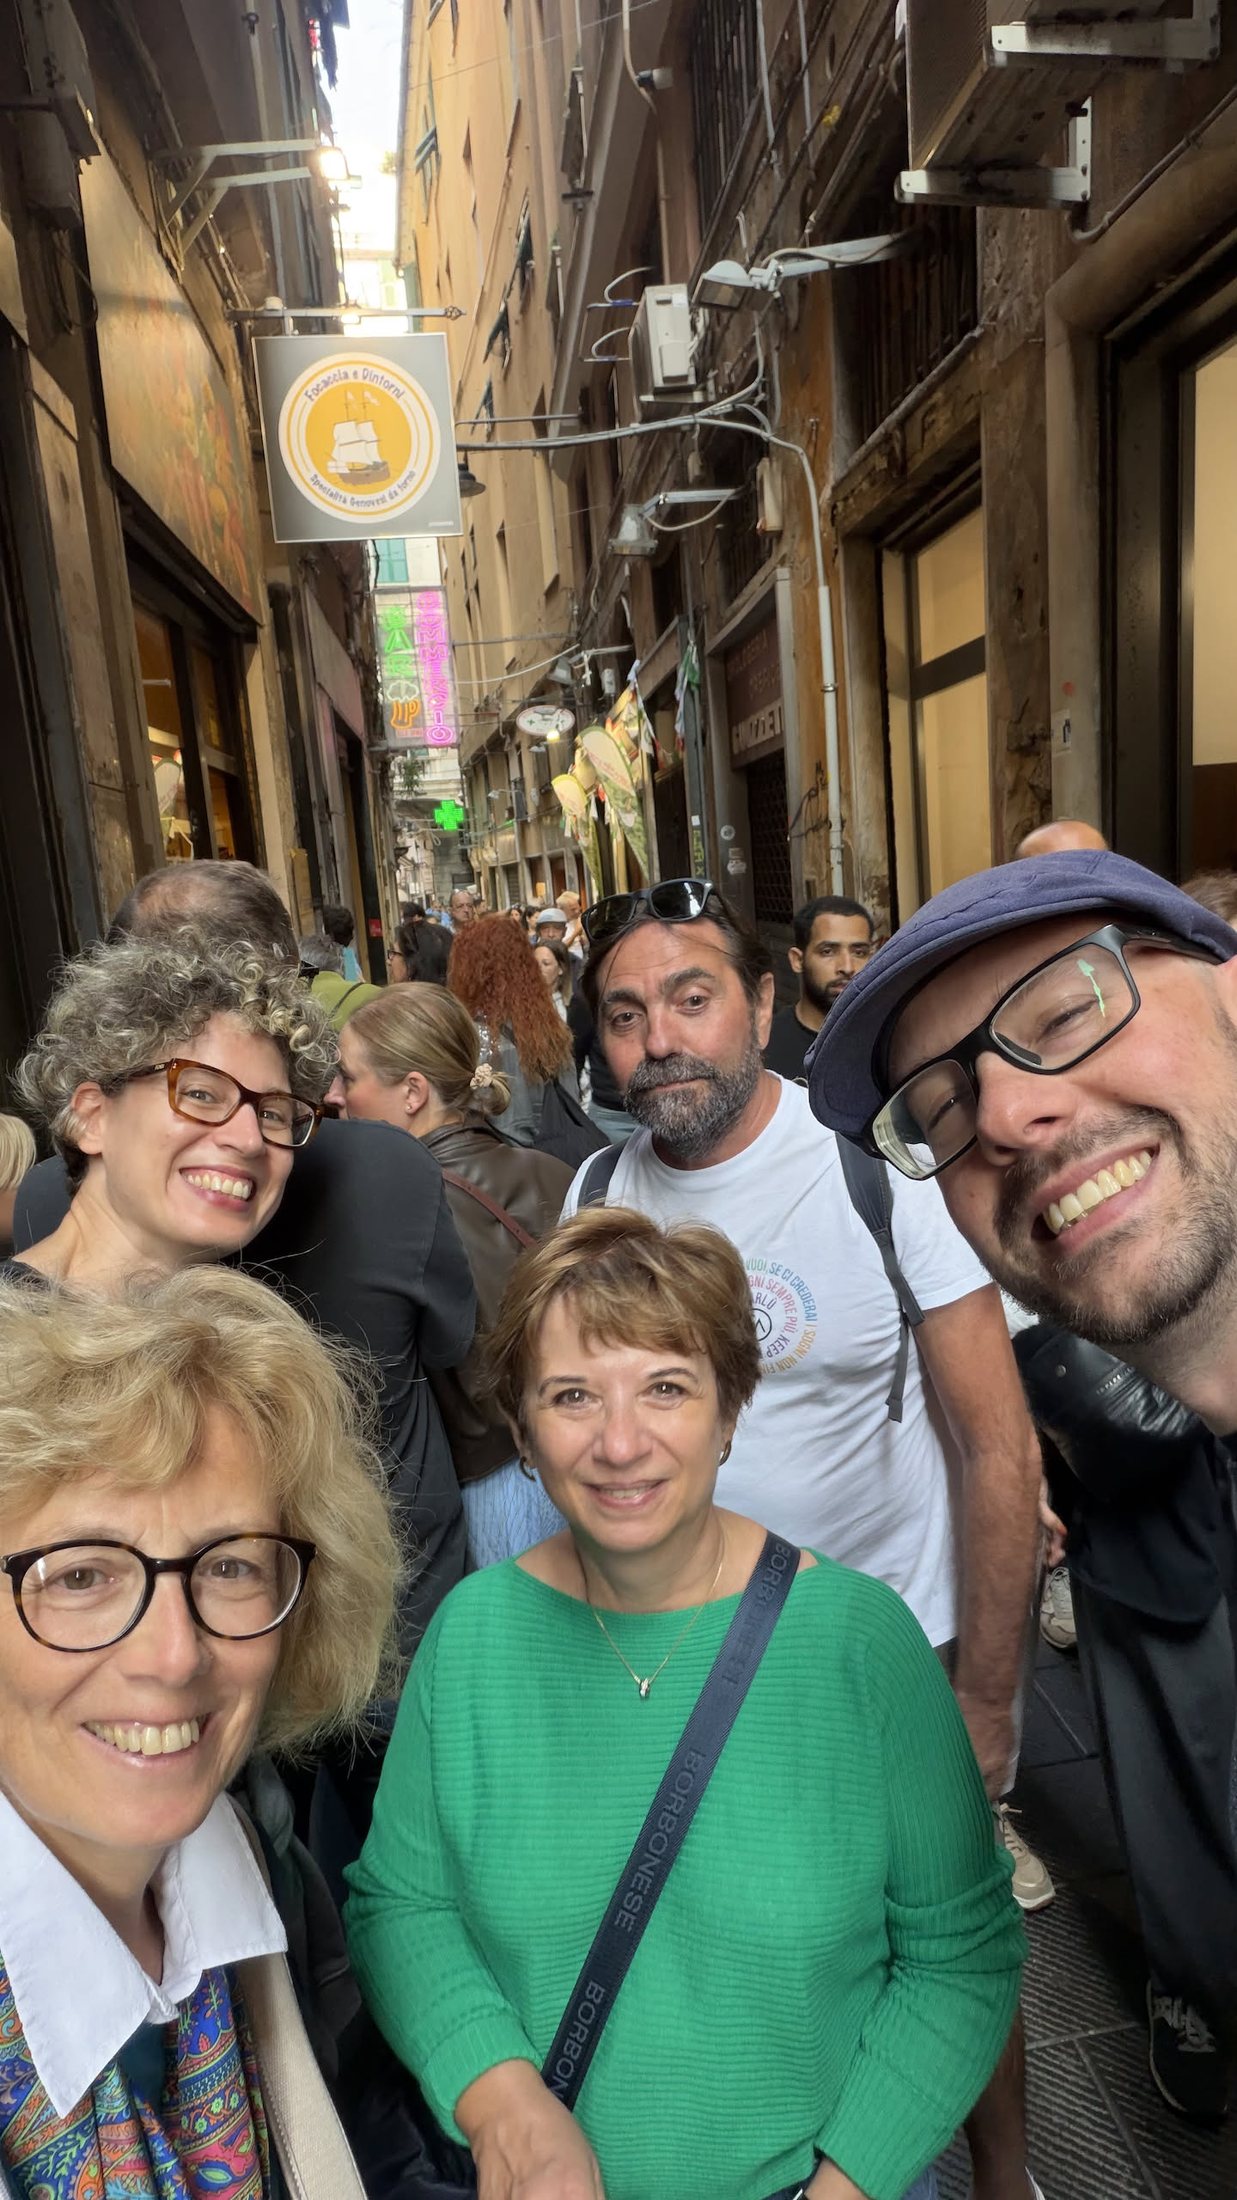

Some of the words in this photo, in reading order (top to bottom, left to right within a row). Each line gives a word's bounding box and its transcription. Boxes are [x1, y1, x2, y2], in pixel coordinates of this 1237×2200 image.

[352, 370, 359, 380] e
[769, 1262, 783, 1276] SE
[781, 1269, 794, 1281] CI
[748, 1275, 765, 1288] GNI
[766, 1279, 797, 1314] SEMPRE
[790, 1276, 817, 1321] CREDERAI
[766, 1334, 790, 1358] KEEP
[795, 1330, 816, 1359] SOGNI
[613, 1750, 707, 1933] BORBONESE
